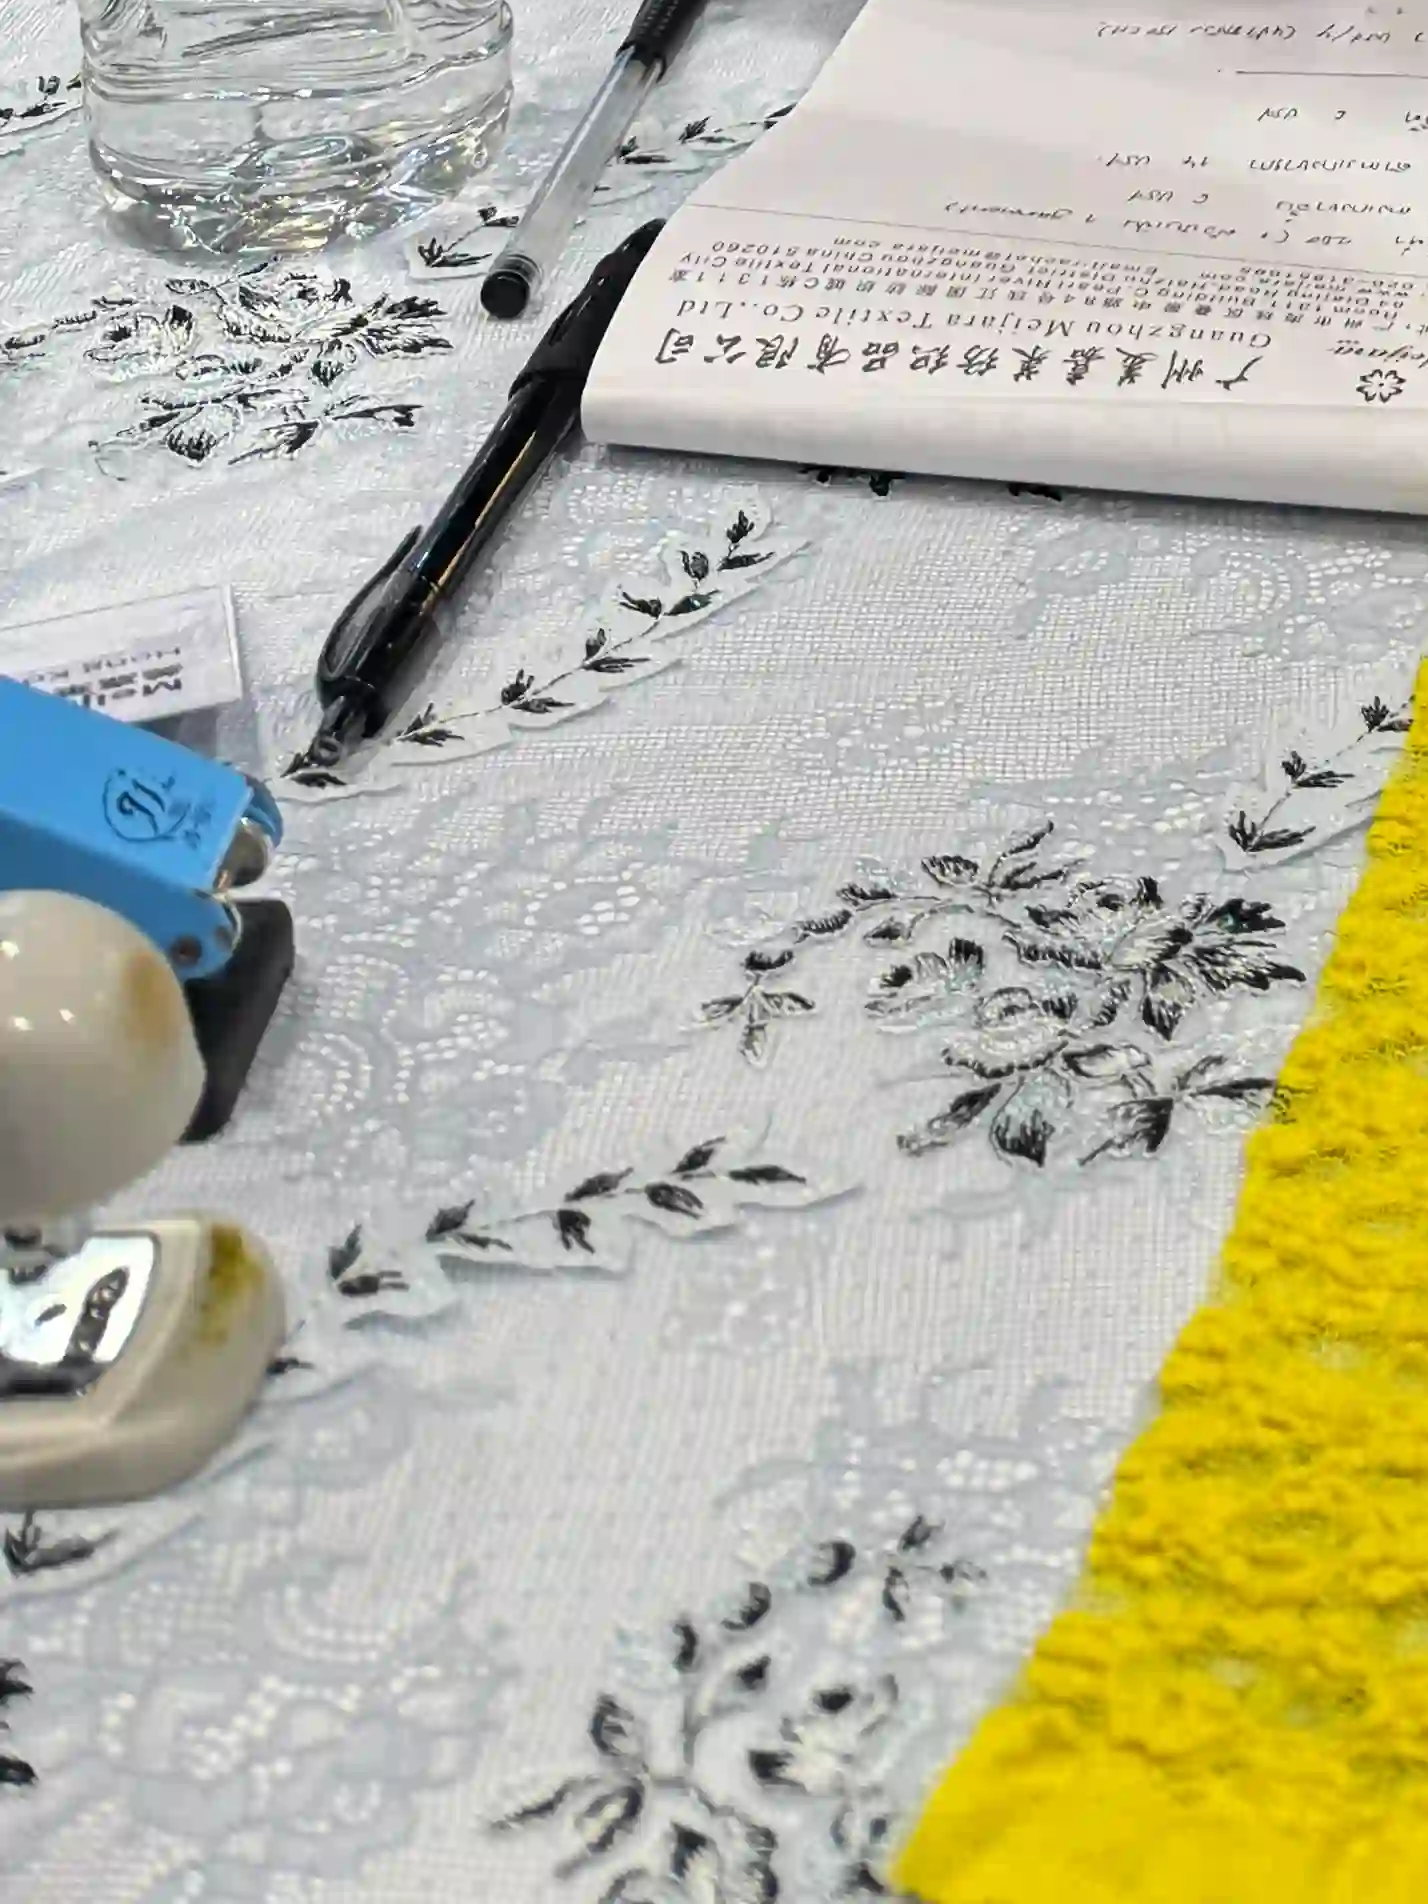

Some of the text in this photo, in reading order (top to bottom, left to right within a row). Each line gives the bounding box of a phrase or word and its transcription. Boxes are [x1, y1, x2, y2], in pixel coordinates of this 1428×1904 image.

[710, 240, 801, 256] 510260
[806, 247, 875, 263] China
[678, 252, 728, 269] City
[734, 257, 815, 274] Textile
[881, 252, 1017, 274] Guangzhou
[820, 262, 982, 286] International
[989, 274, 1051, 290] River
[1058, 280, 1122, 296] Pearl
[1156, 287, 1257, 308] Building
[814, 305, 933, 331] Textile
[1333, 305, 1398, 322] Room
[946, 311, 1076, 338] Meijara
[1085, 321, 1272, 350] Guangzhou
